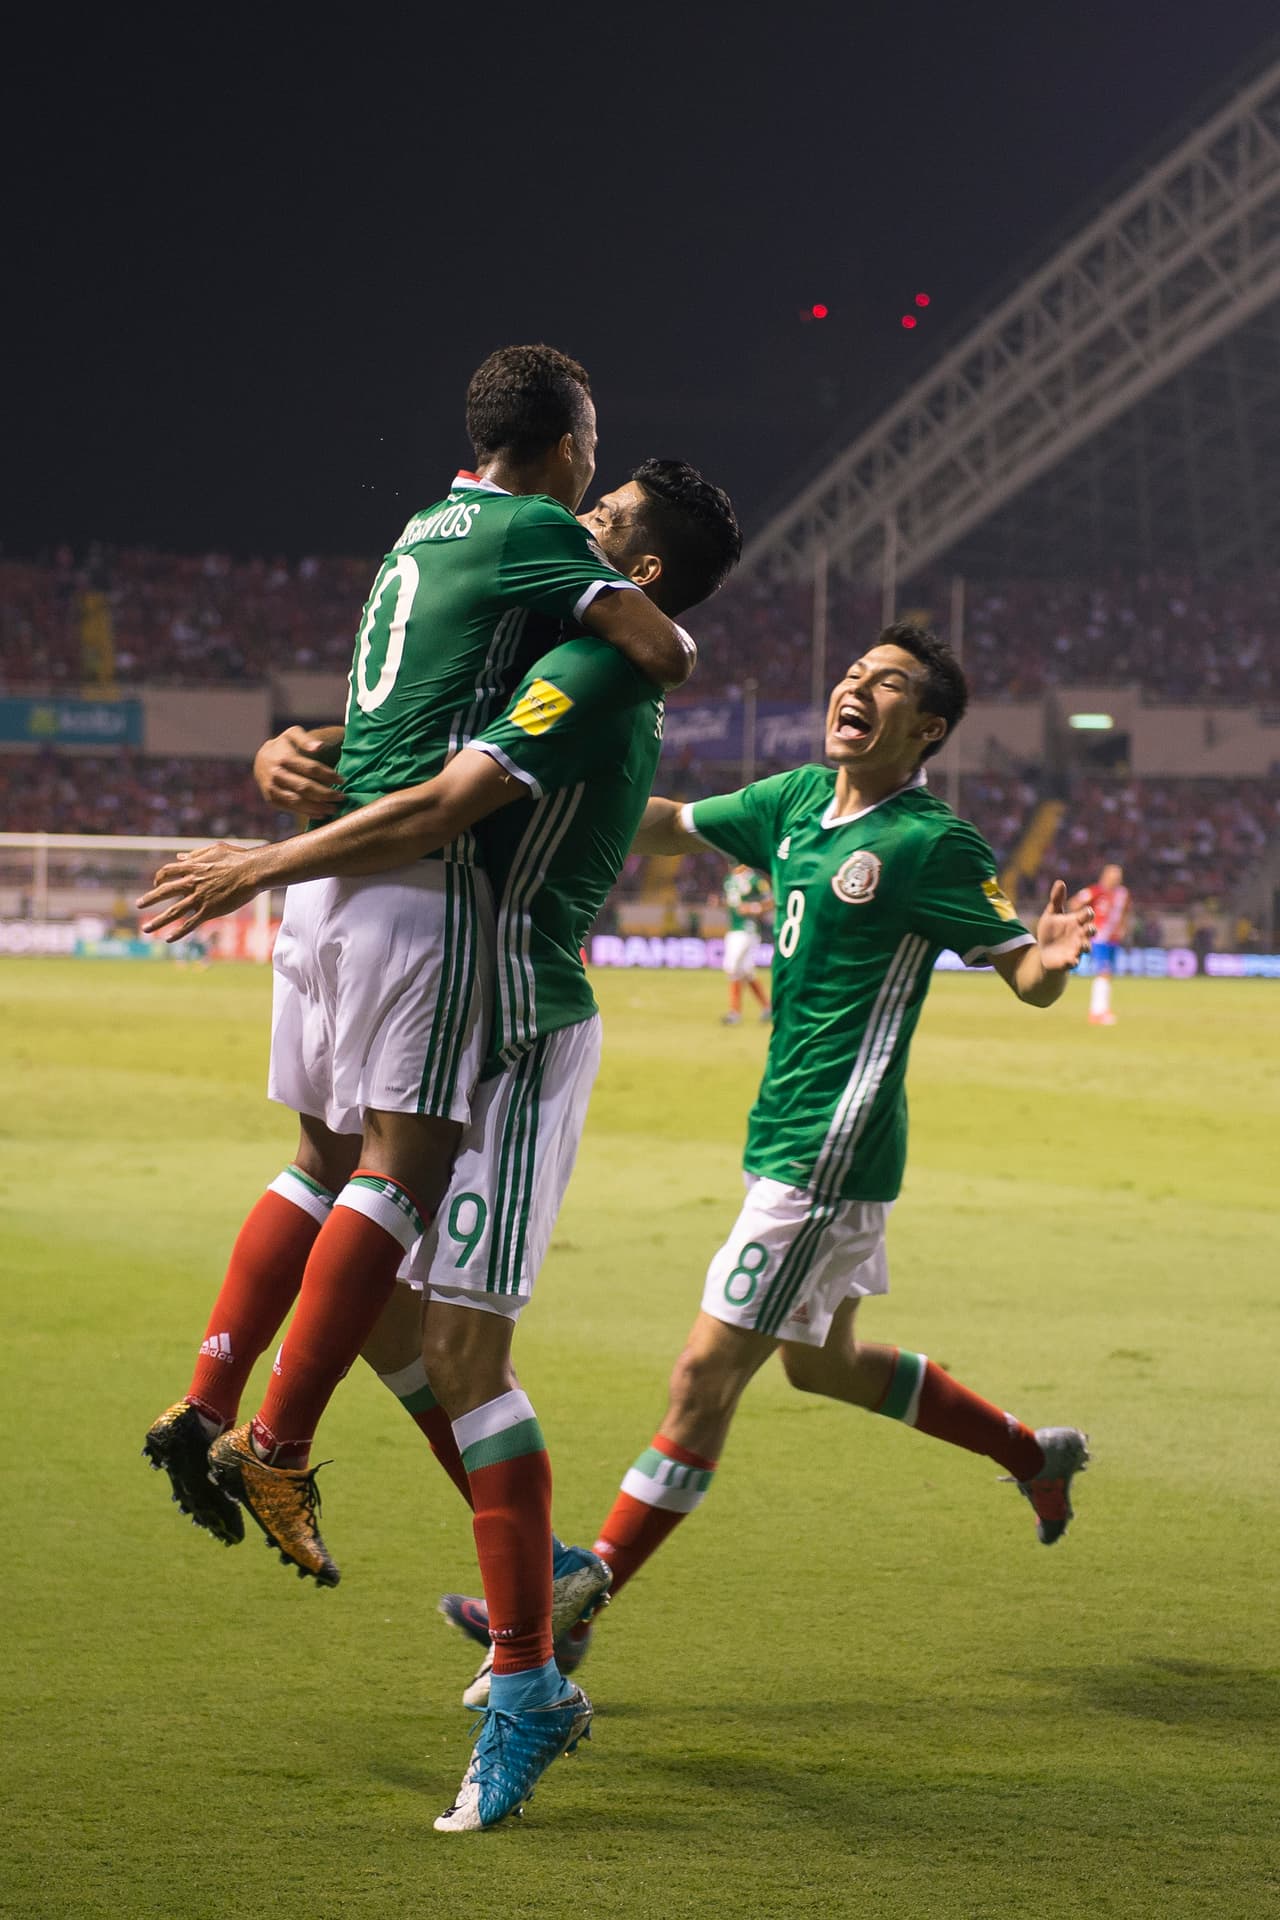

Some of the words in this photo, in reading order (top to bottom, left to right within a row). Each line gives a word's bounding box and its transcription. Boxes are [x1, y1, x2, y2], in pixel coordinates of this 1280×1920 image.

[778, 889, 806, 958] 8
[447, 1191, 488, 1268] 9
[724, 1241, 769, 1308] 8
